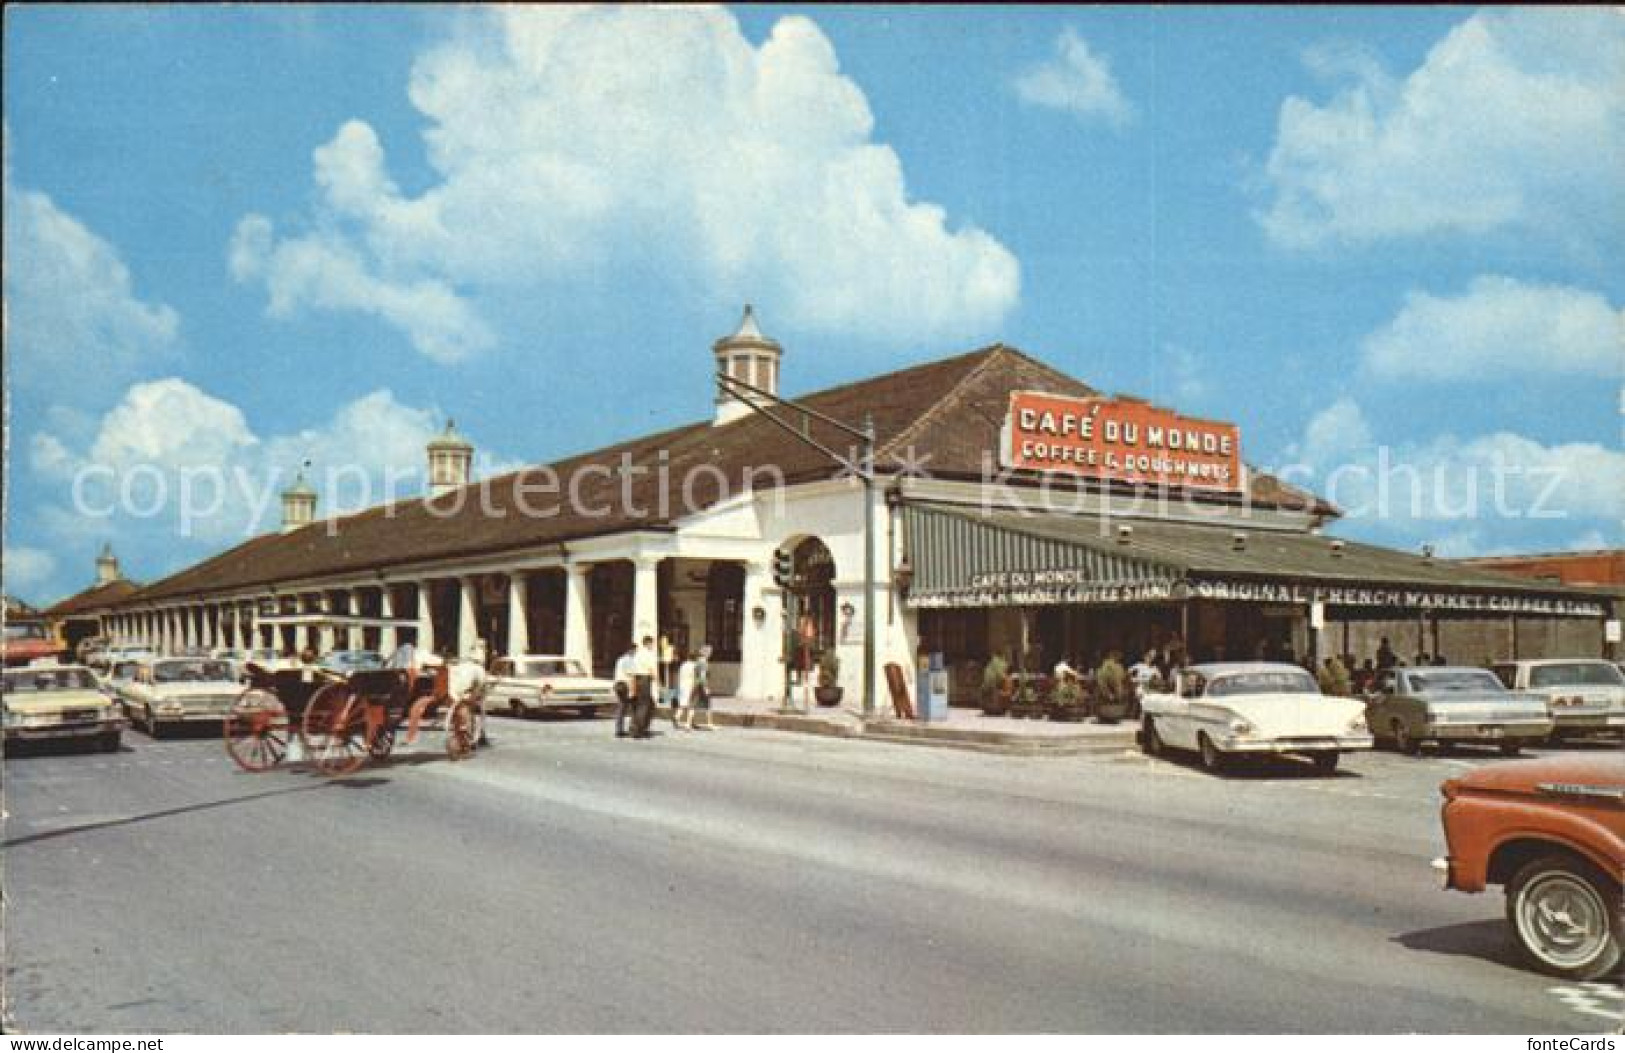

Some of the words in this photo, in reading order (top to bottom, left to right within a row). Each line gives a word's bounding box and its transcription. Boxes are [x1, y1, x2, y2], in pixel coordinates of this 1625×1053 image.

[1020, 405, 1099, 438] CAFÉ
[1105, 419, 1138, 445] DU
[1147, 425, 1232, 455] MONDE
[1022, 440, 1096, 465] COFFEE
[1105, 452, 1118, 470] &
[1125, 454, 1230, 481] DOUGHNUTS
[1199, 580, 1308, 602] ORIGINAL
[1313, 585, 1400, 605] FRENCH
[1406, 591, 1484, 610] MARKET
